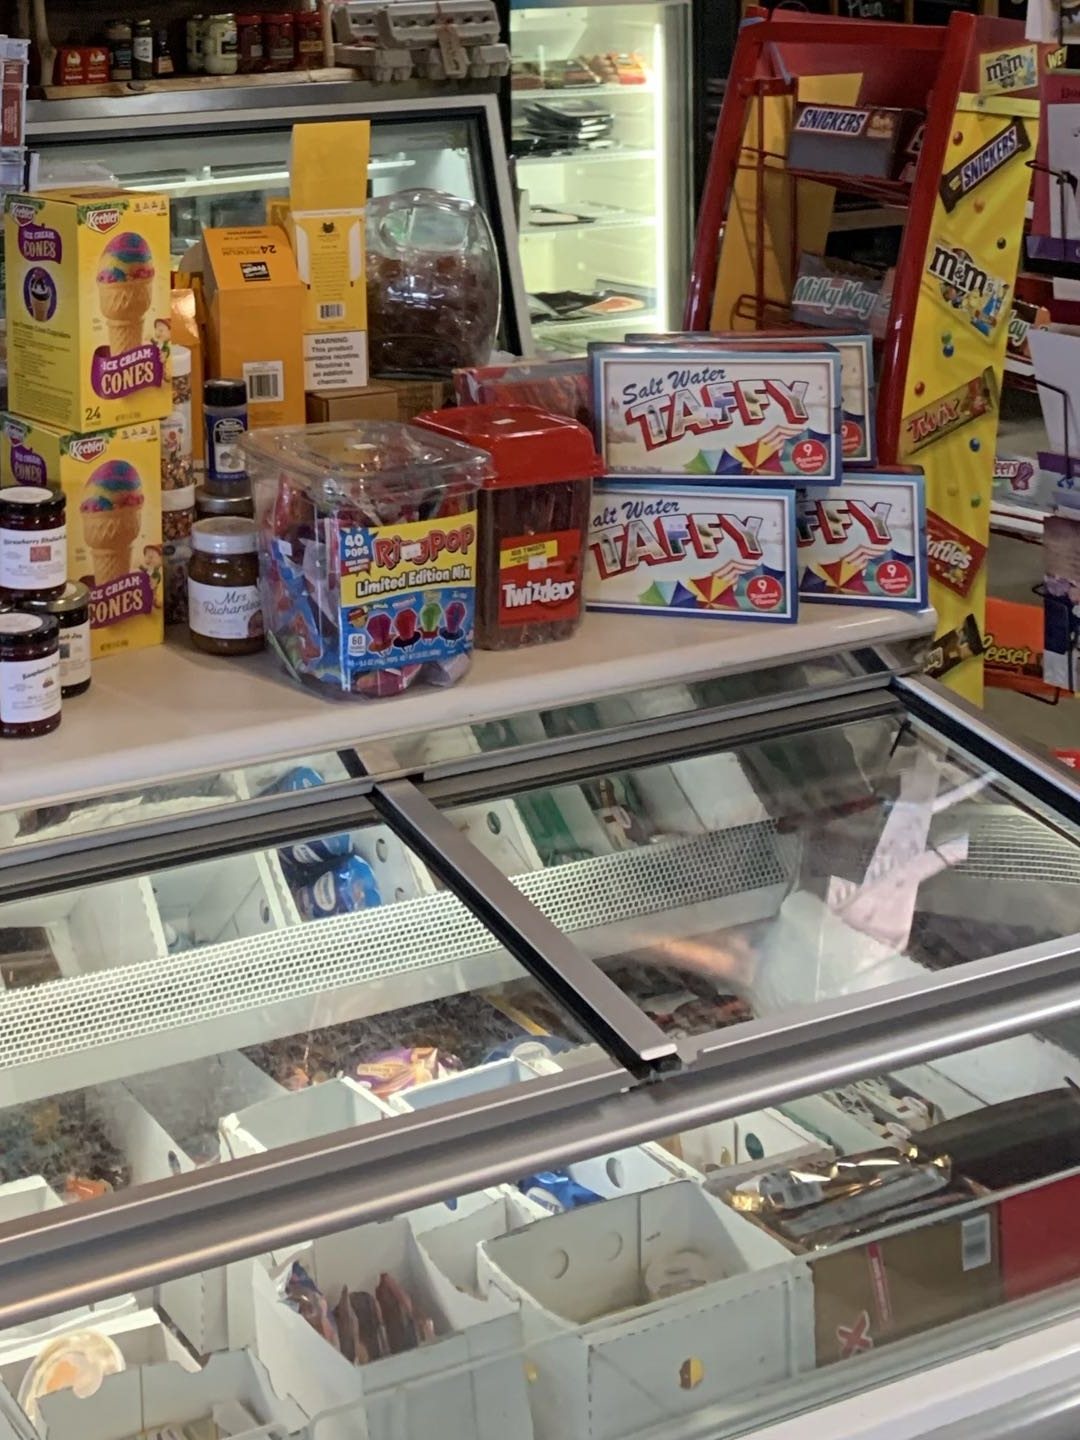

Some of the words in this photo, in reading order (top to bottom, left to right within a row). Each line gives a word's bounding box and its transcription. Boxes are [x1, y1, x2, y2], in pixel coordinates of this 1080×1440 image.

[800, 107, 866, 135] SNICKERS
[962, 125, 1017, 190] SNICKERS
[88, 210, 119, 225] Keebler
[23, 240, 56, 259] CONES
[102, 359, 118, 372] ICE
[120, 347, 152, 368] CREAM
[101, 361, 154, 396] CONES
[622, 378, 663, 407] Salt
[668, 367, 726, 389] Water
[85, 406, 101, 421] 24
[625, 378, 811, 452] TAFFY
[72, 439, 105, 457] Keebler
[802, 443, 813, 457] 9
[590, 508, 618, 529] alt
[621, 499, 680, 520] Water
[345, 534, 364, 547] 40
[591, 513, 764, 581] TAFFY
[345, 546, 370, 558] POPS
[886, 563, 897, 578] 9
[106, 575, 140, 594] CREAM
[356, 572, 407, 599] Limited
[408, 566, 450, 588] Edition
[451, 563, 473, 582] Mix
[757, 579, 767, 593] 9
